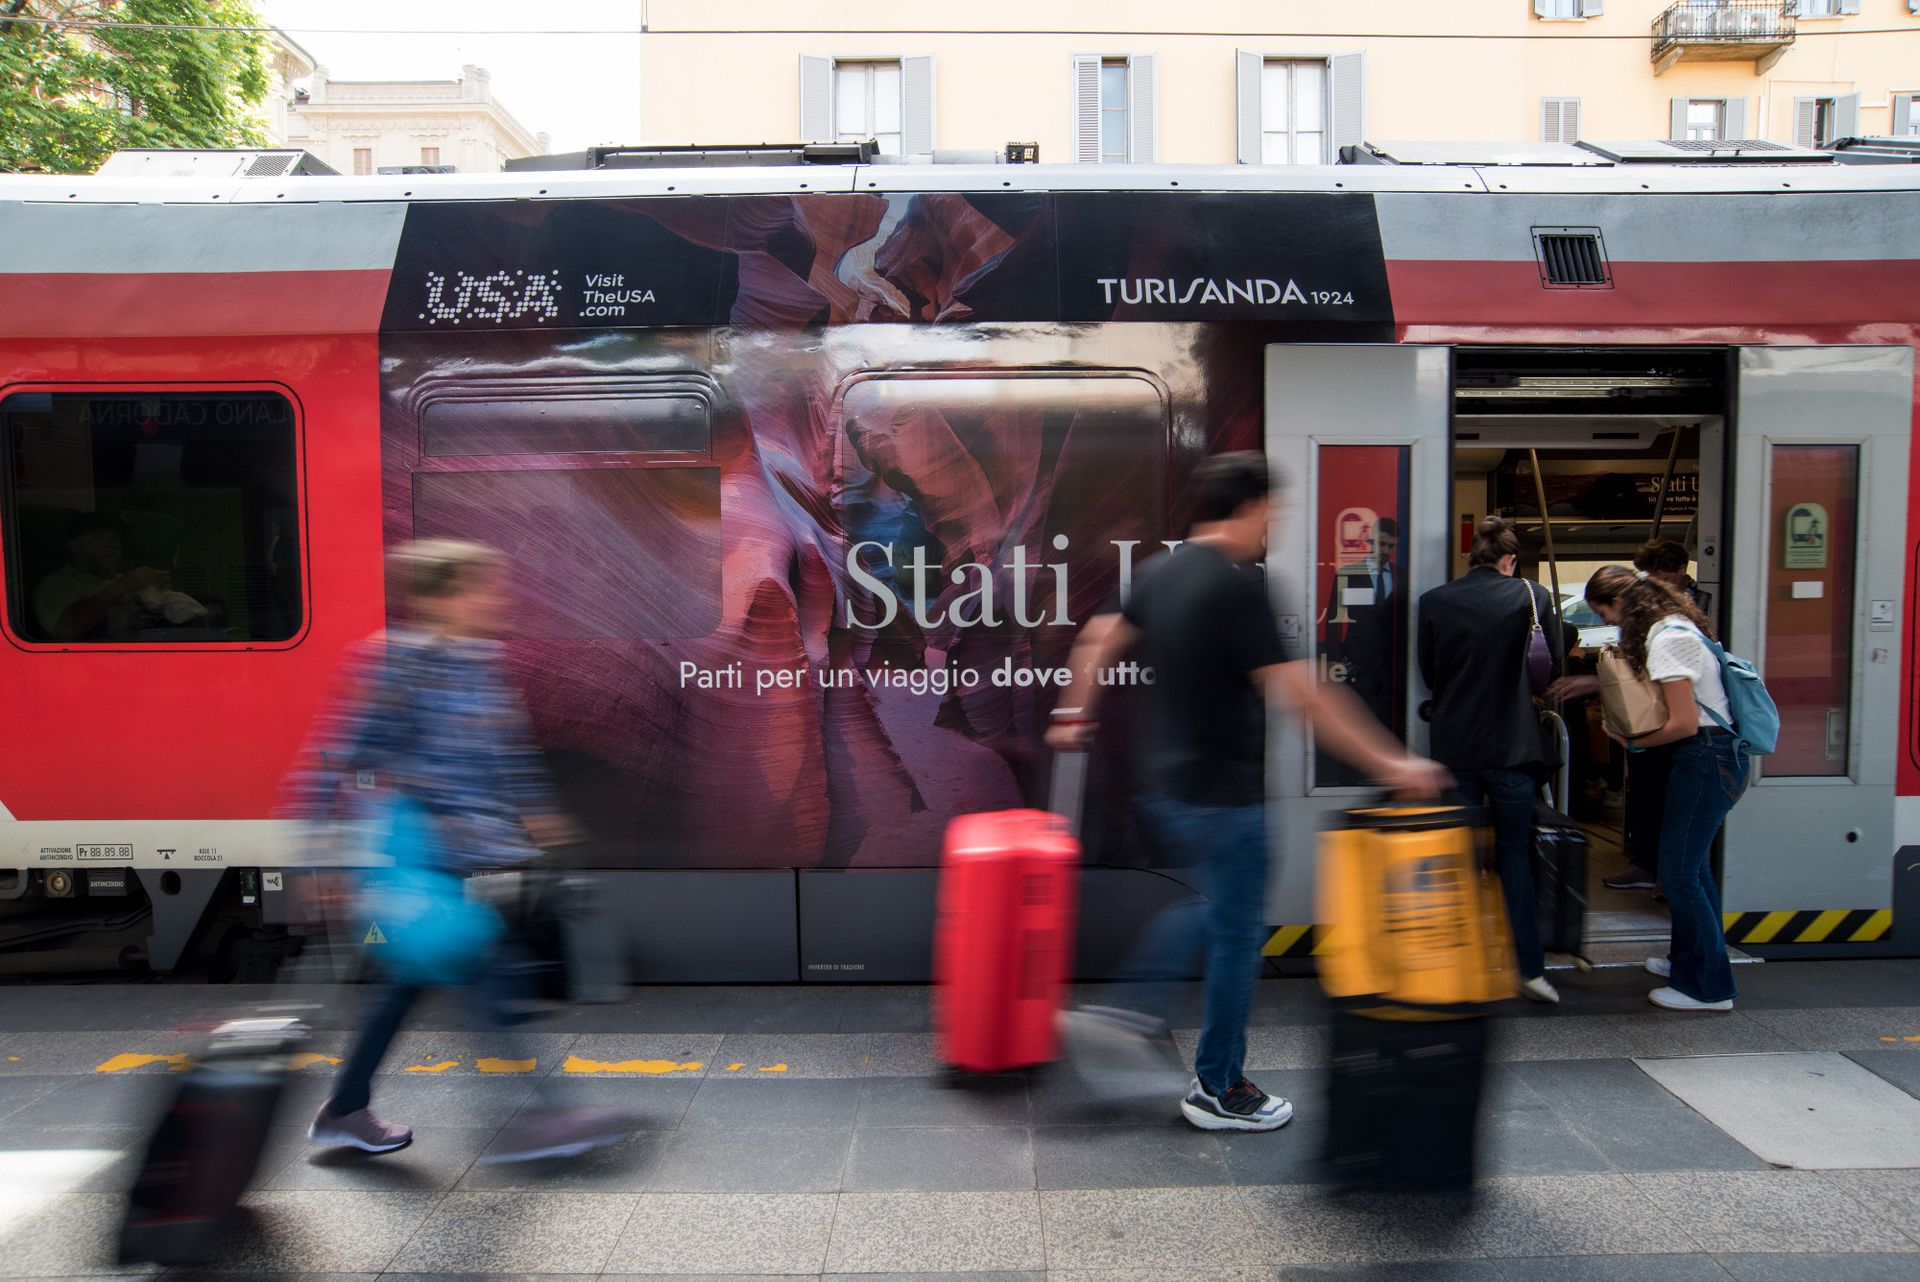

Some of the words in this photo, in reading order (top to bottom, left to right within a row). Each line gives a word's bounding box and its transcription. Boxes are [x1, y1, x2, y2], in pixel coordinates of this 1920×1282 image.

[585, 273, 625, 288] Visit
[420, 270, 562, 324] USA
[583, 289, 656, 304] TheUSA
[1097, 278, 1308, 305] TURISANDA
[1310, 291, 1355, 305] 1924
[579, 304, 626, 317] .com
[845, 533, 1077, 629] Stati
[679, 660, 743, 688] Parti
[756, 667, 806, 699] per
[818, 667, 853, 688] un
[865, 659, 980, 695] viaggio
[991, 657, 1073, 687] dove
[79, 847, 88, 857] Pr
[90, 880, 125, 888] ANTINCENDIO
